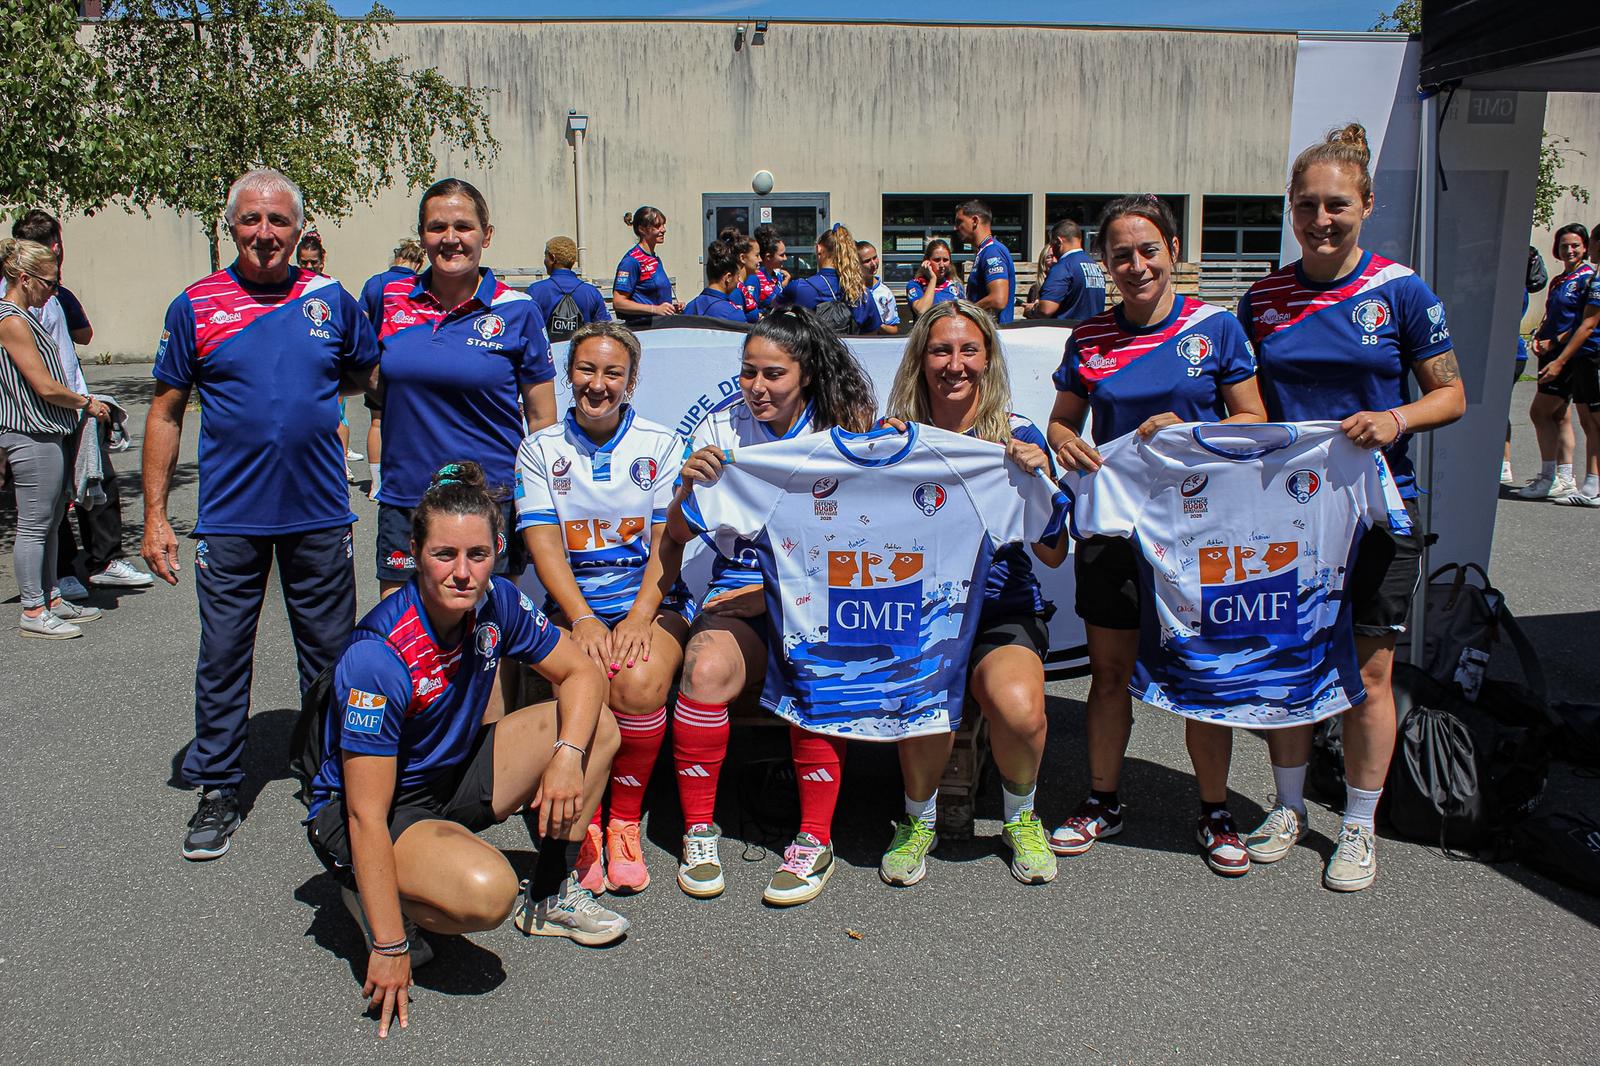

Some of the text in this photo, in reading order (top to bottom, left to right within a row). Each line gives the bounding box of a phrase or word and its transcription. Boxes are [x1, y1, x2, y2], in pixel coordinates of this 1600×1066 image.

[554, 320, 577, 331] GMF
[310, 328, 330, 339] AGG
[466, 337, 504, 350] STAFF
[1361, 335, 1378, 345] 58
[1187, 367, 1202, 377] 57
[675, 374, 742, 444] UIPE DE
[386, 556, 416, 566] SAMUR
[1209, 591, 1291, 625] GMF
[836, 600, 915, 632] GMF
[347, 710, 380, 728] GMF
